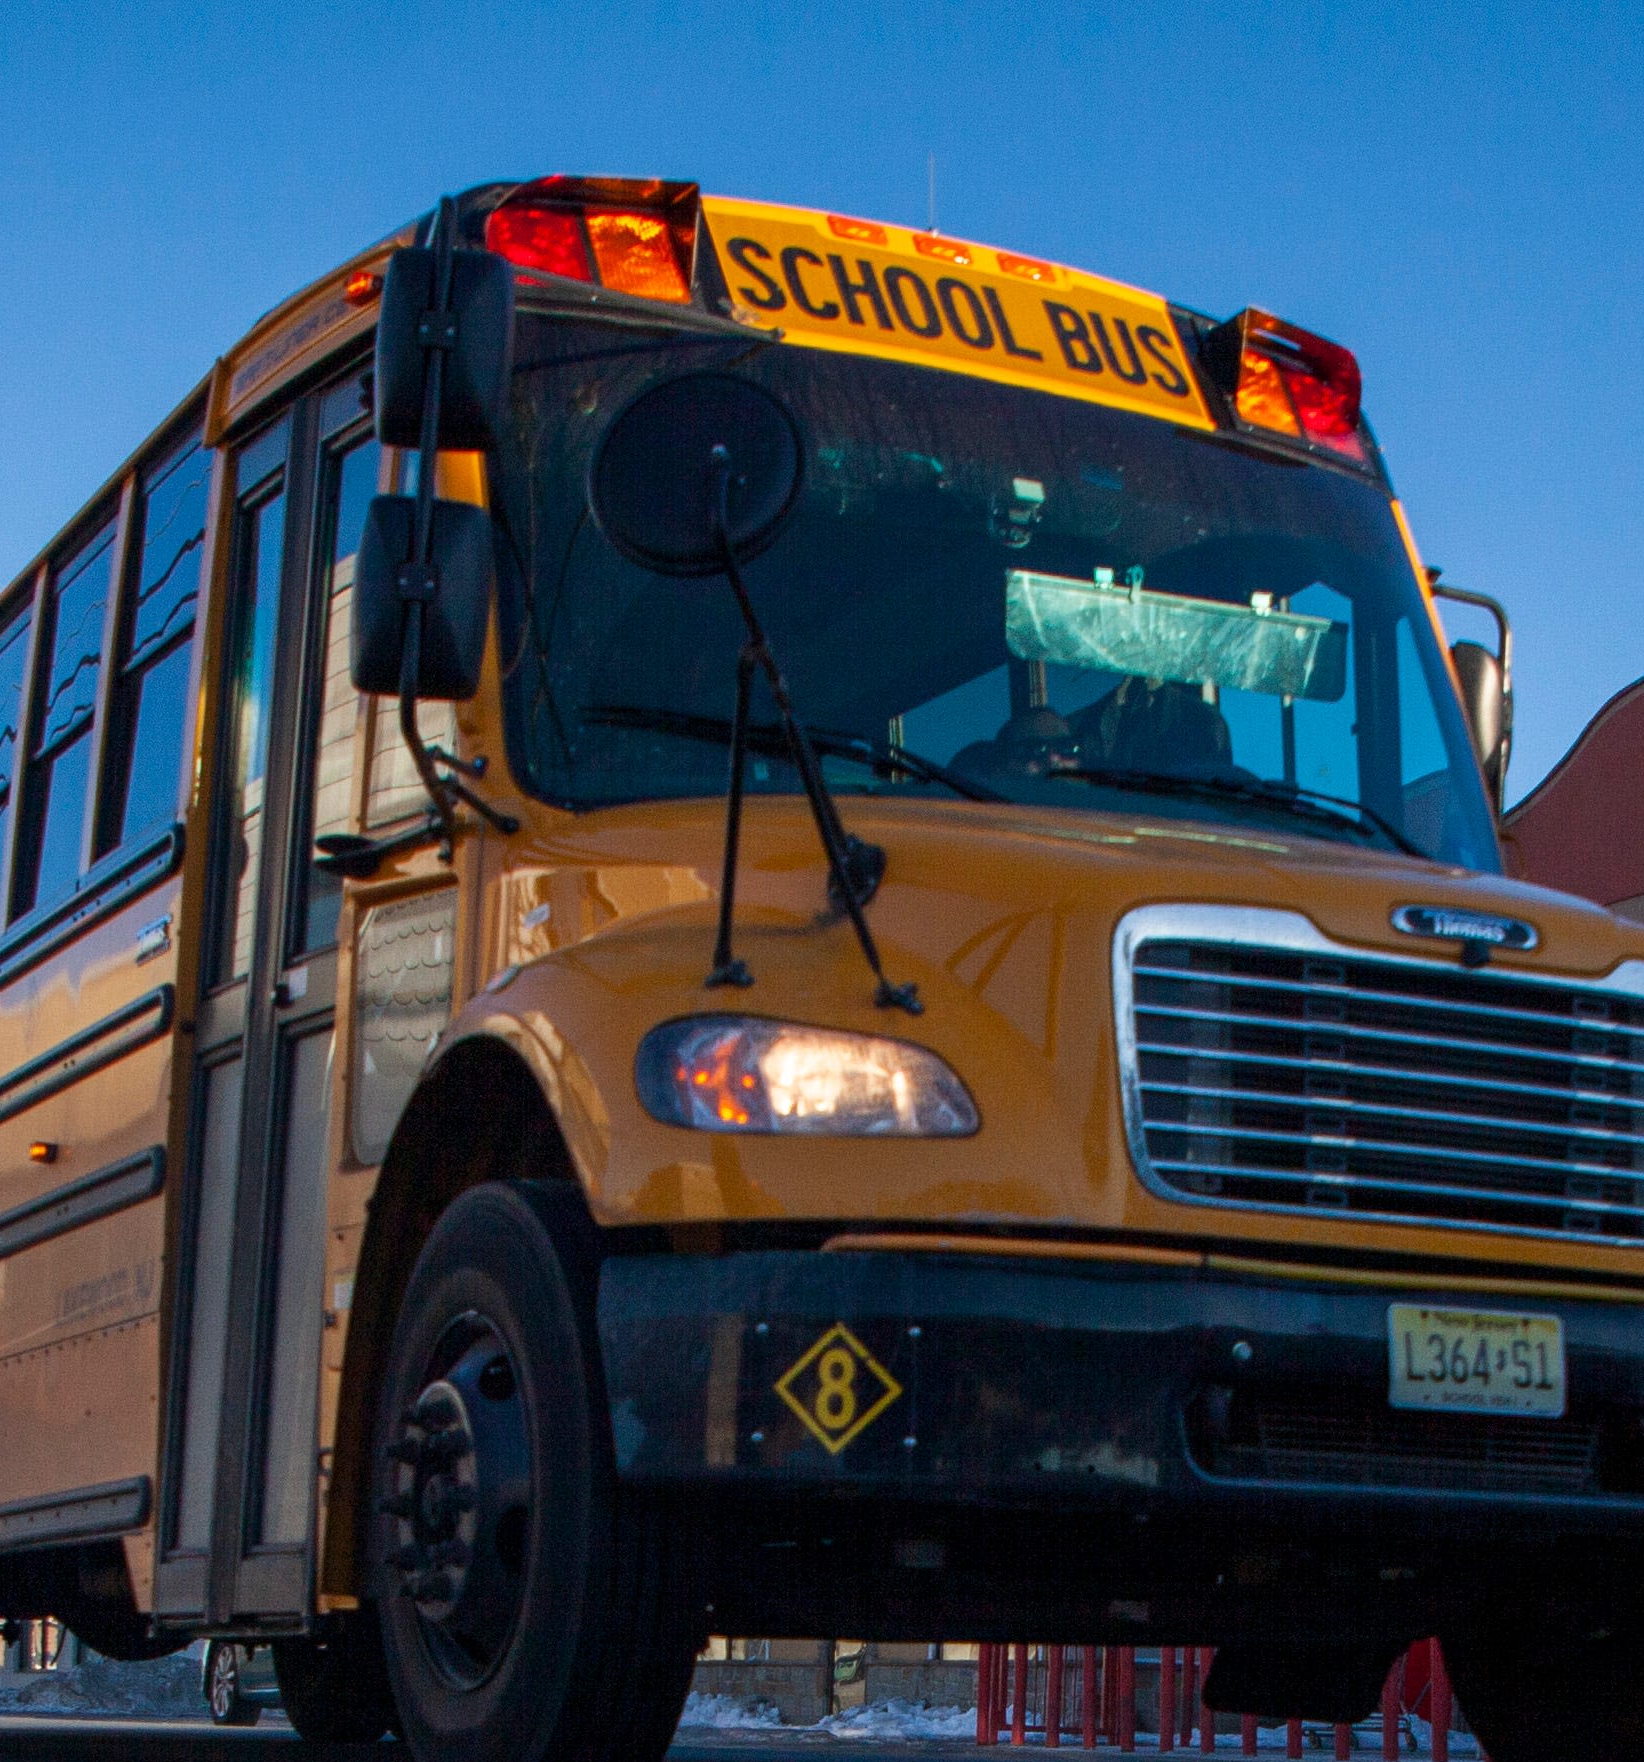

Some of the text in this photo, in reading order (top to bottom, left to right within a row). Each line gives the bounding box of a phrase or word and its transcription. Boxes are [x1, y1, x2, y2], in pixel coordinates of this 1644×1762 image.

[726, 235, 1192, 398] SCHOOL BUS
[815, 1348, 856, 1429] 8
